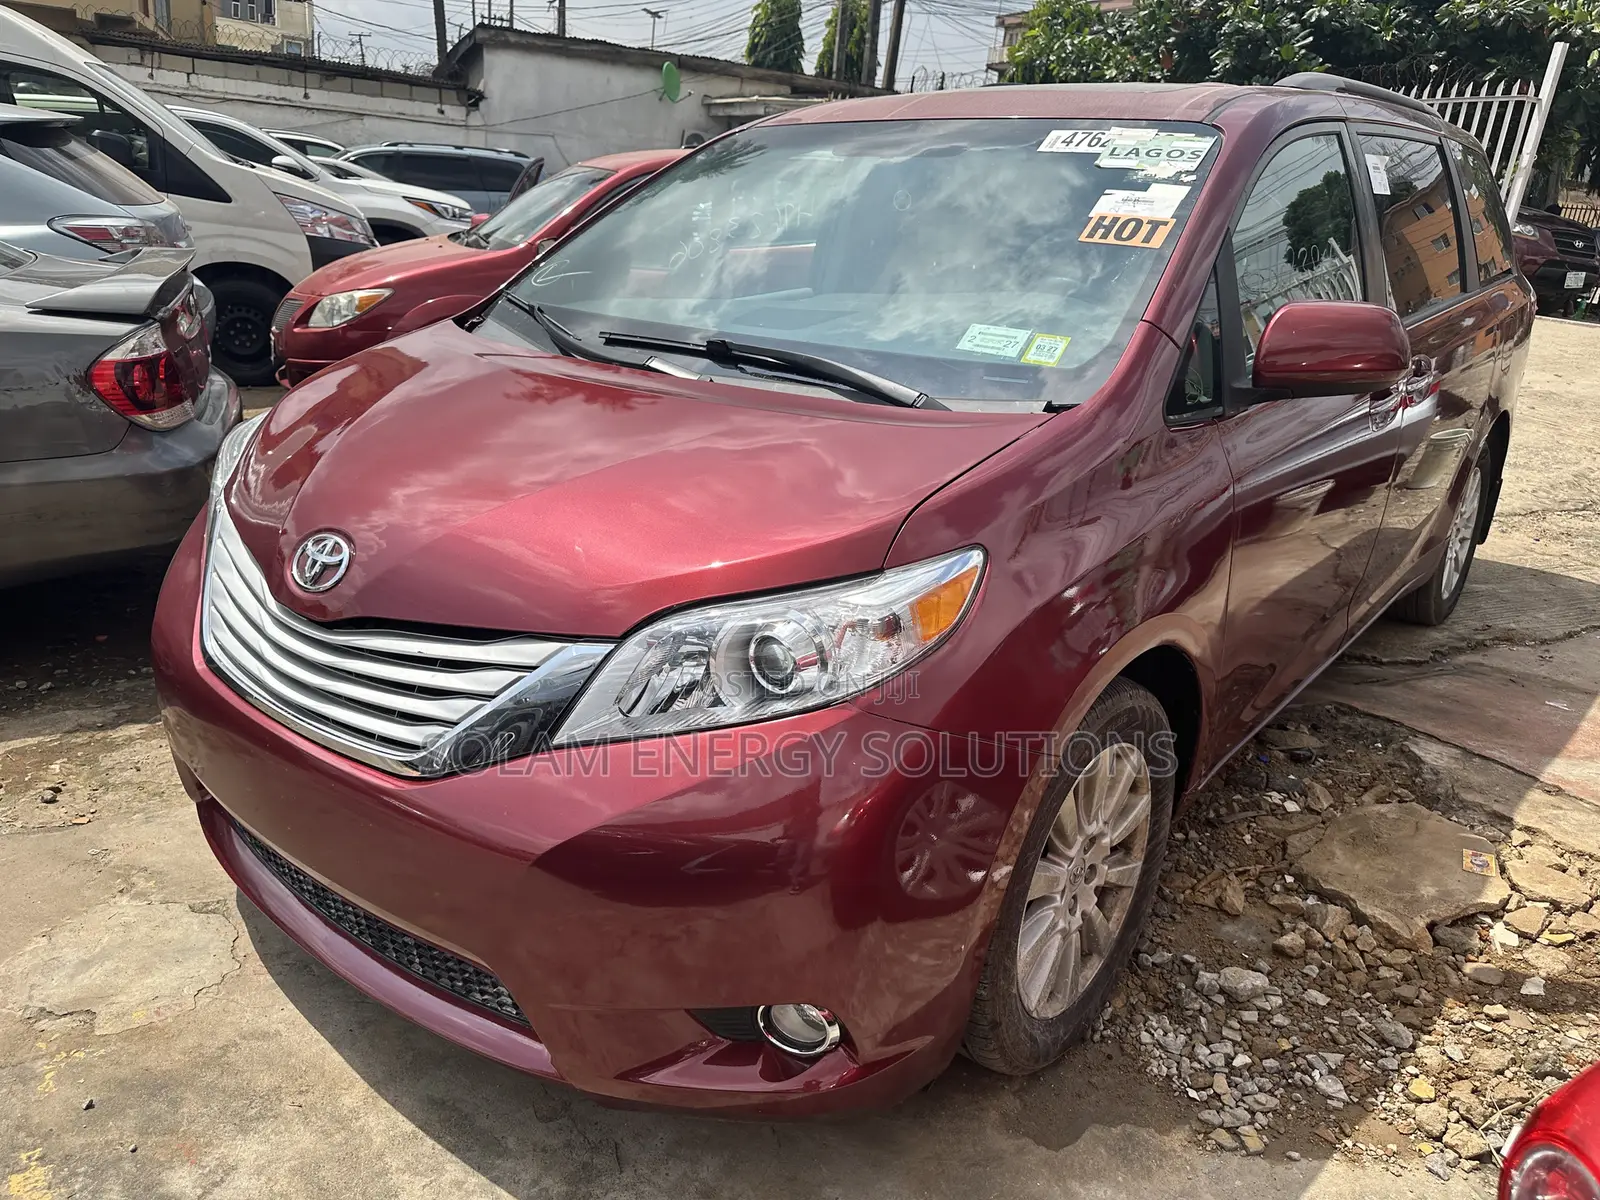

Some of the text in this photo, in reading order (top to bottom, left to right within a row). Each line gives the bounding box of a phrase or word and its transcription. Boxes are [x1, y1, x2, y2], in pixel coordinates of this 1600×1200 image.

[1108, 147, 1204, 160] LAGOS
[1085, 215, 1169, 244] HOT
[1003, 340, 1020, 349] 27
[1036, 343, 1059, 353] 03 27
